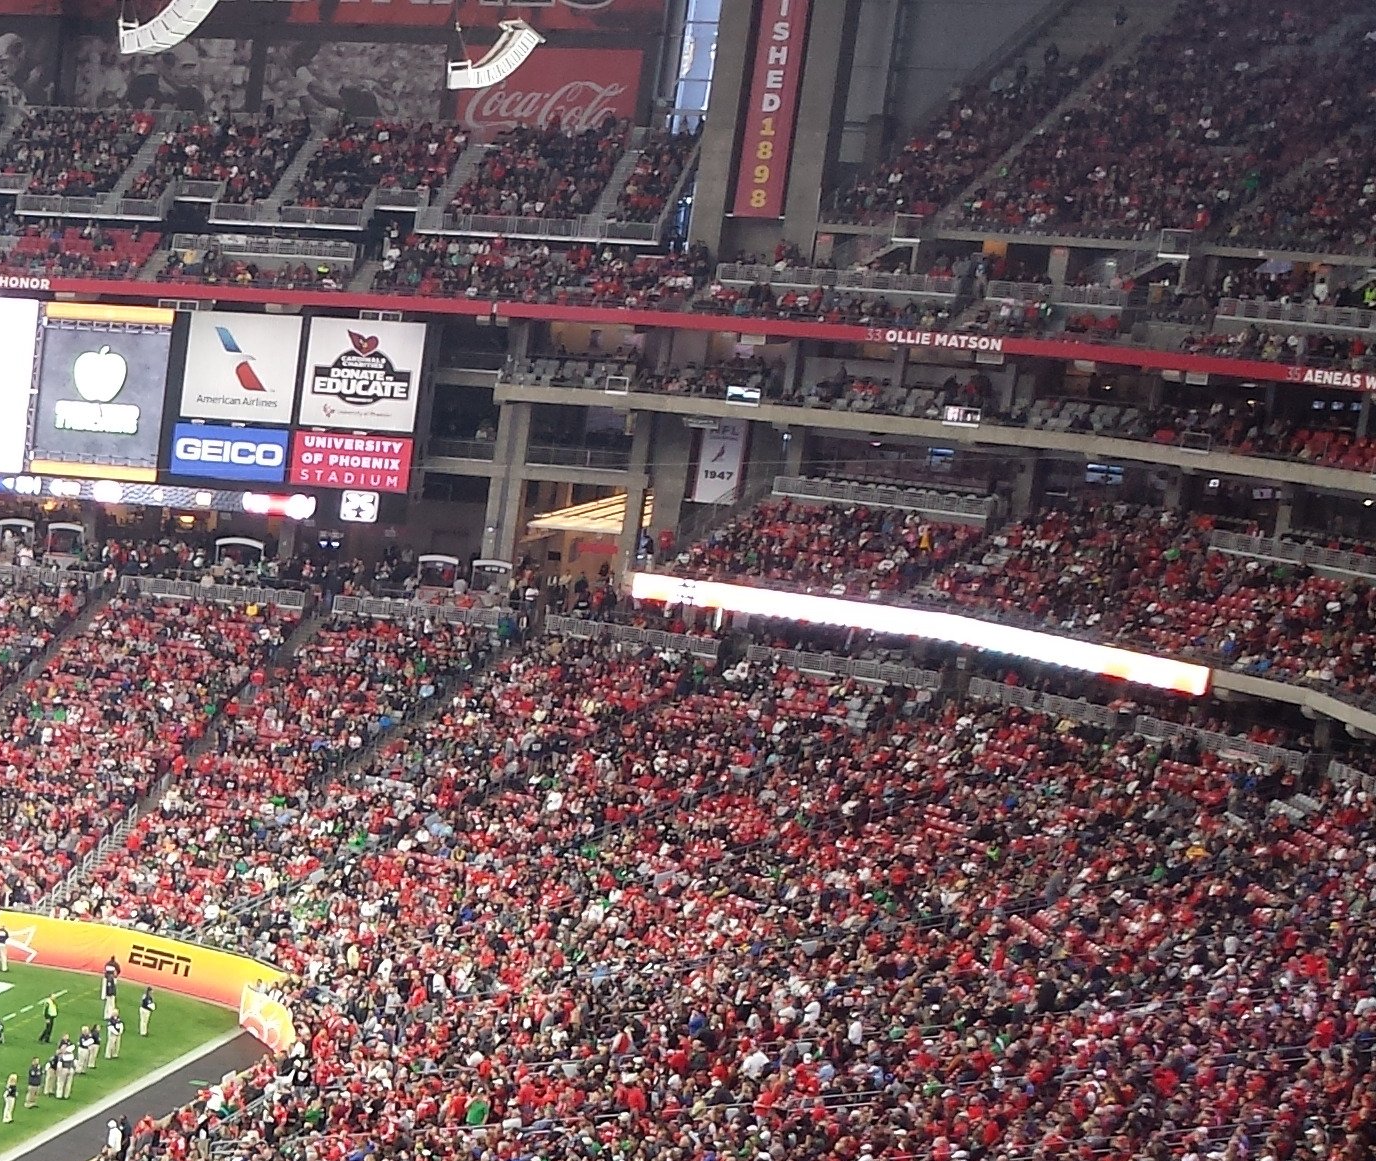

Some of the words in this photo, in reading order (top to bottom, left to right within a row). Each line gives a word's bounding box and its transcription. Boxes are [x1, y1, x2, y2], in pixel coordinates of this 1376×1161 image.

[750, 117, 776, 208] 1898
[865, 329, 881, 341] 33
[885, 330, 931, 345] OLLIE
[935, 333, 1003, 351] MATSON
[330, 368, 386, 380] DONATE
[1303, 369, 1361, 388] AENEAS
[314, 376, 408, 398] EDUCATE
[197, 394, 241, 405] American
[242, 397, 278, 408] Airlines
[176, 437, 284, 467] GEICO
[304, 436, 403, 454] UNIVERSITY
[301, 452, 323, 464] OF
[329, 455, 401, 471] PHOENIX
[300, 469, 399, 488] STADIUM
[704, 469, 734, 480] 1947
[129, 944, 191, 977] ESPN
